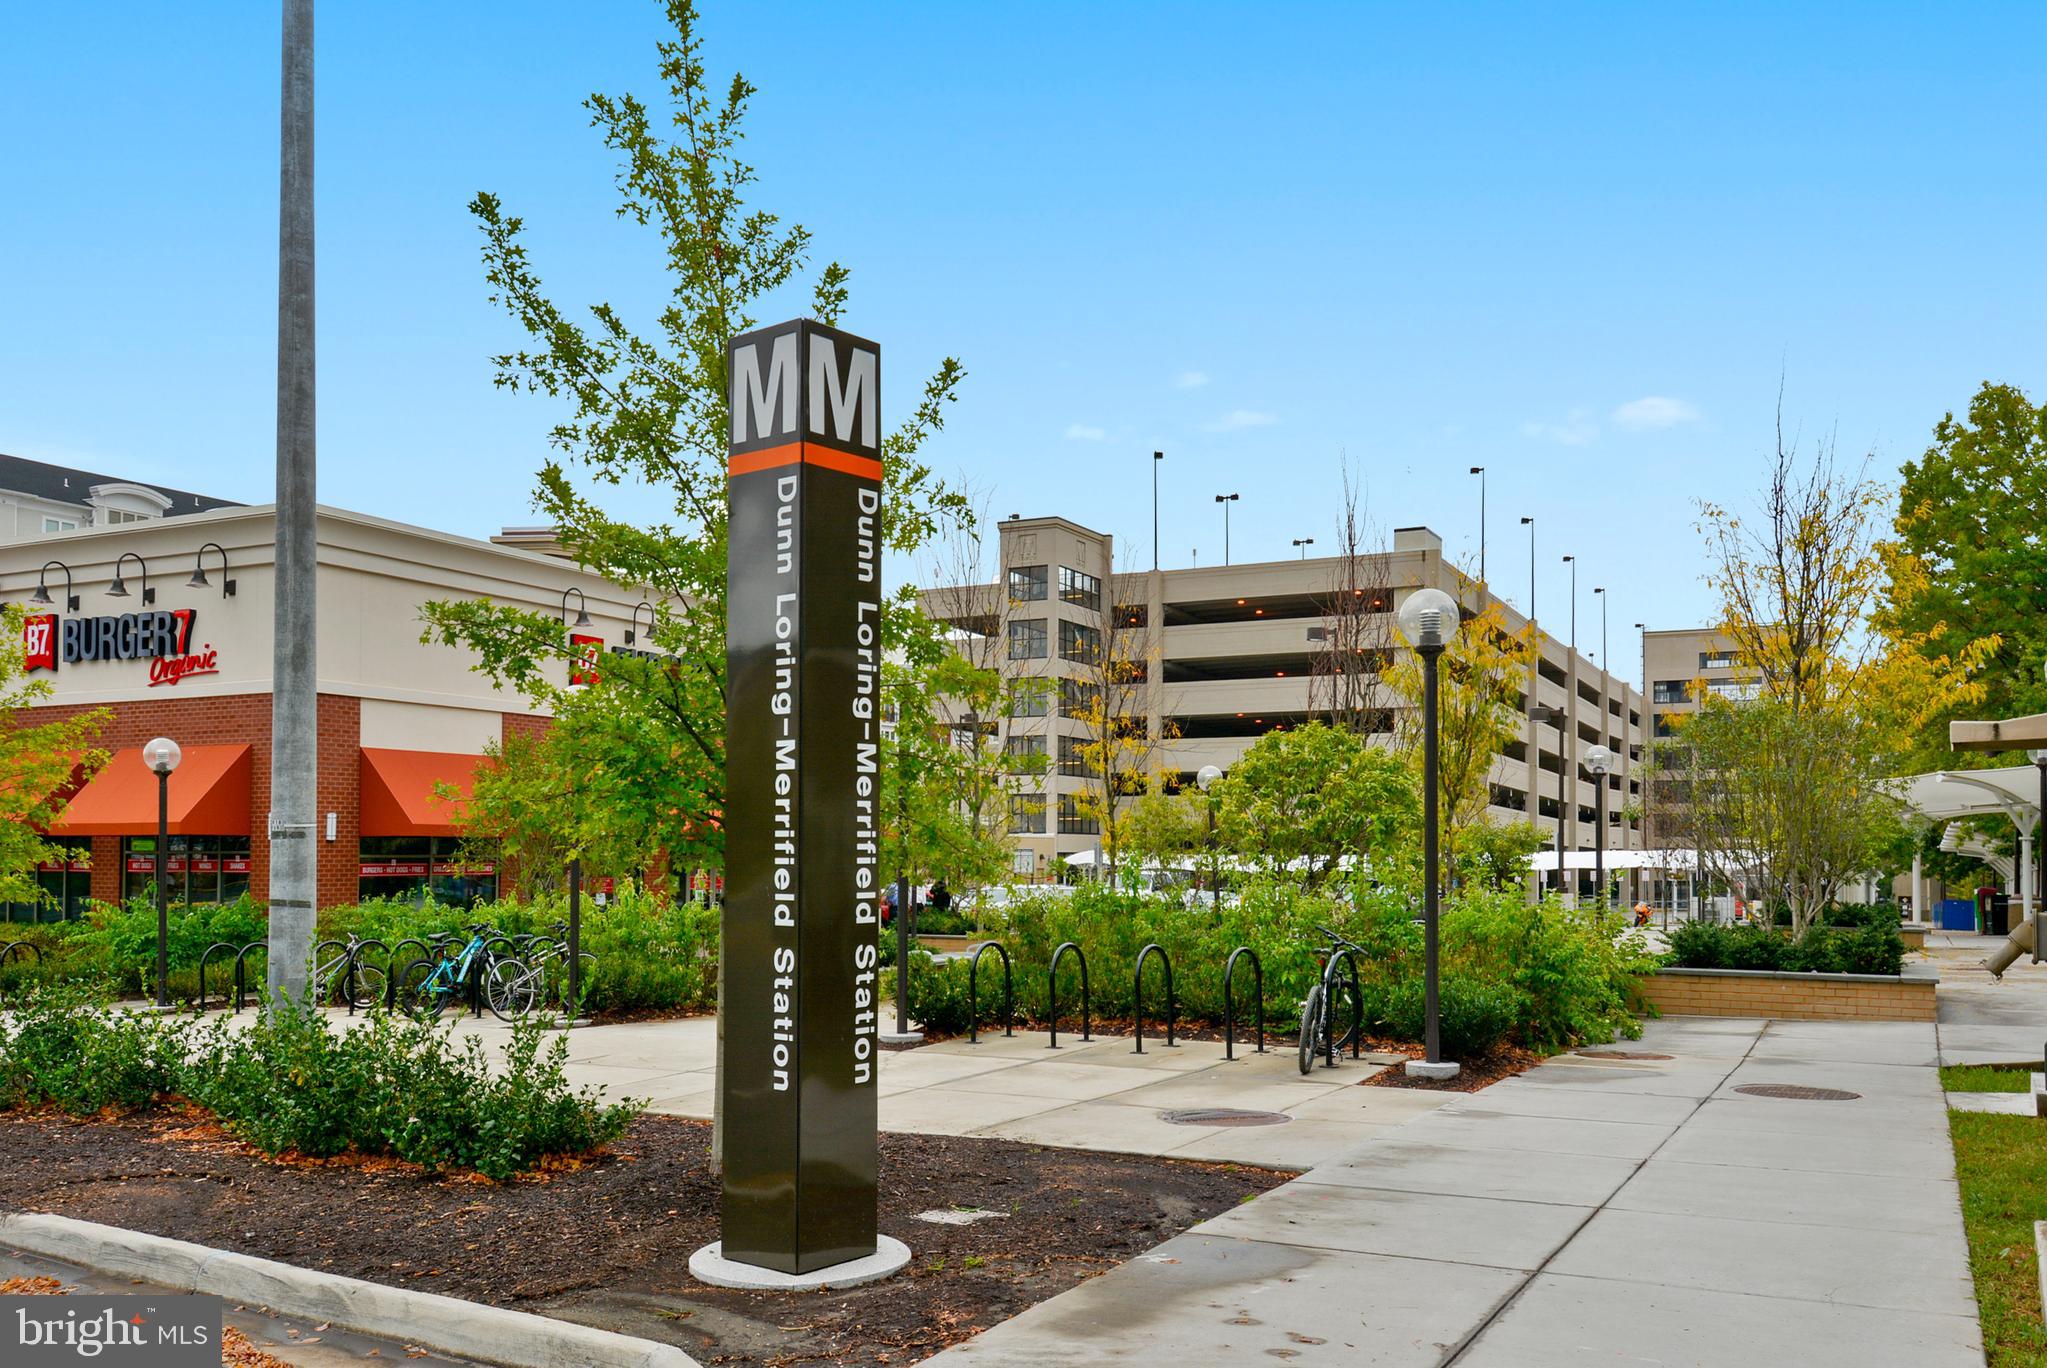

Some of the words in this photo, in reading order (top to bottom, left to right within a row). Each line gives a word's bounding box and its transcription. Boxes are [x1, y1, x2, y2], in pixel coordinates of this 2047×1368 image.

[732, 332, 798, 445] M
[808, 332, 876, 449] M
[776, 474, 798, 575] Dunn
[858, 487, 878, 582] Dunn
[149, 643, 217, 686] Organic
[771, 592, 797, 927] Loring-Merrifield
[852, 601, 878, 924] Loring-Merrifield
[773, 947, 795, 1092] Station
[855, 944, 877, 1084] Station
